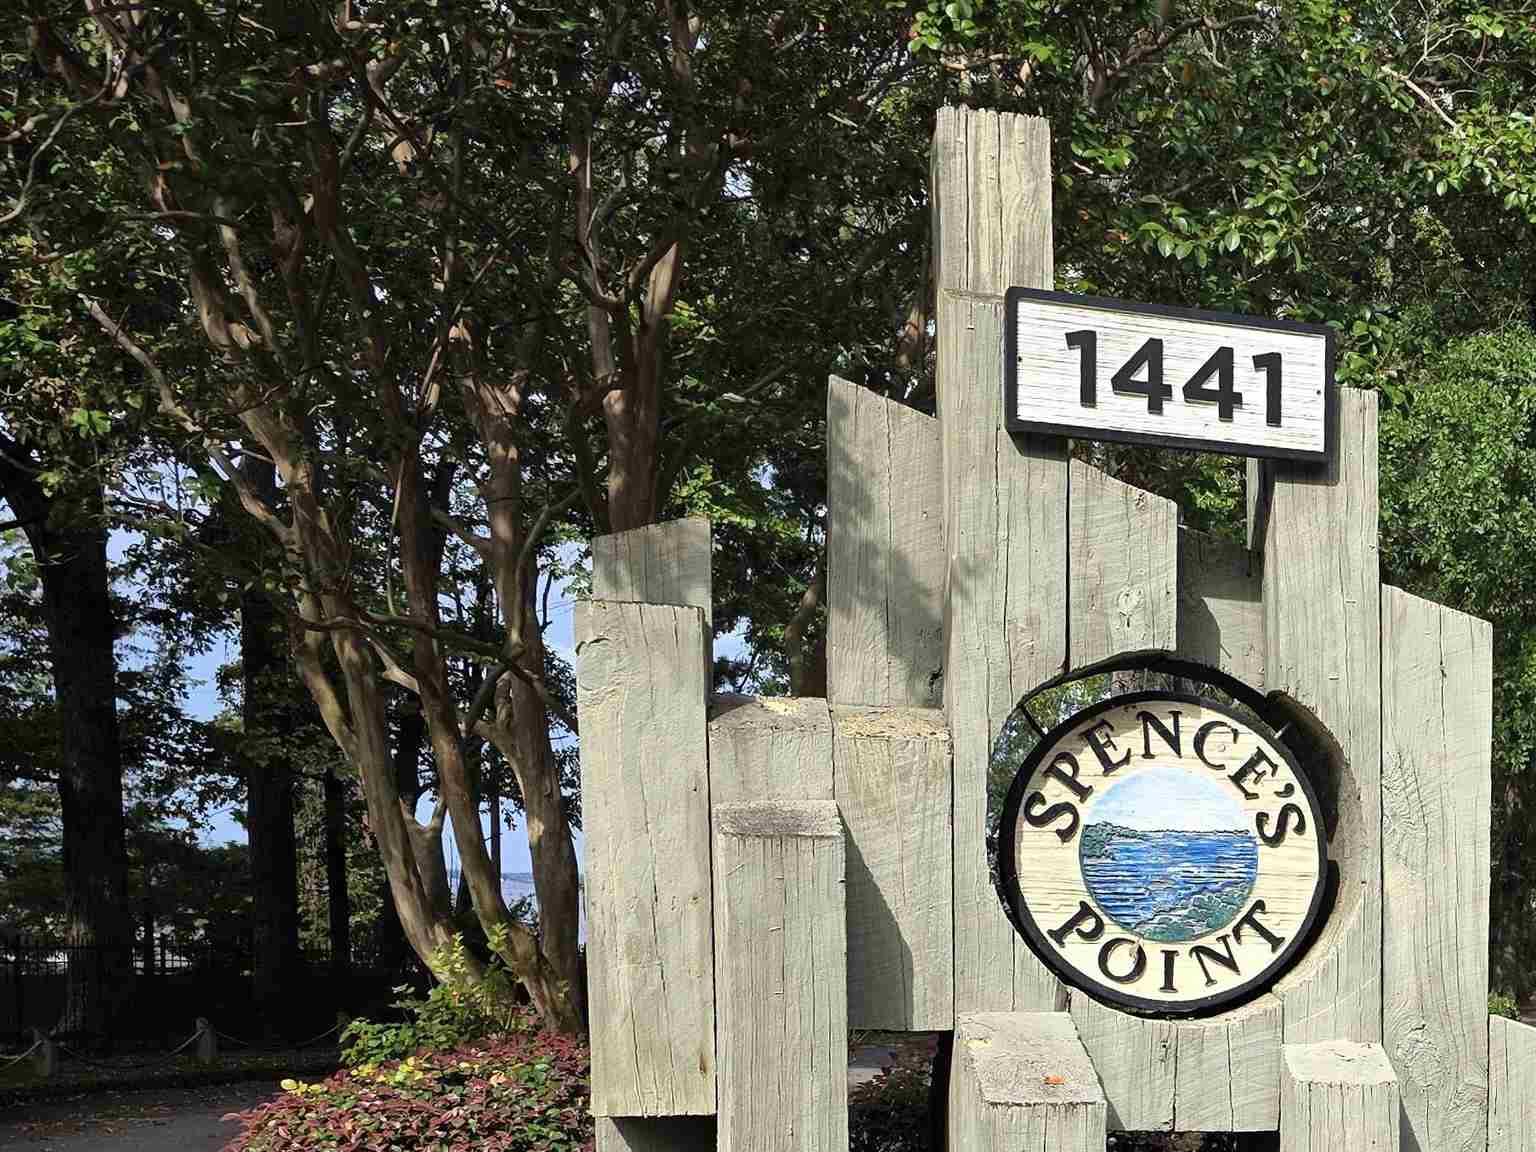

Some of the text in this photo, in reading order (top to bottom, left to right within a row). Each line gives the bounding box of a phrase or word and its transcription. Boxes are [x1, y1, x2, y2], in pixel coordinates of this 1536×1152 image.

[1065, 330, 1283, 427] 1441
[1023, 710, 1306, 849] SPENCE'S
[1047, 899, 1287, 993] POINT
